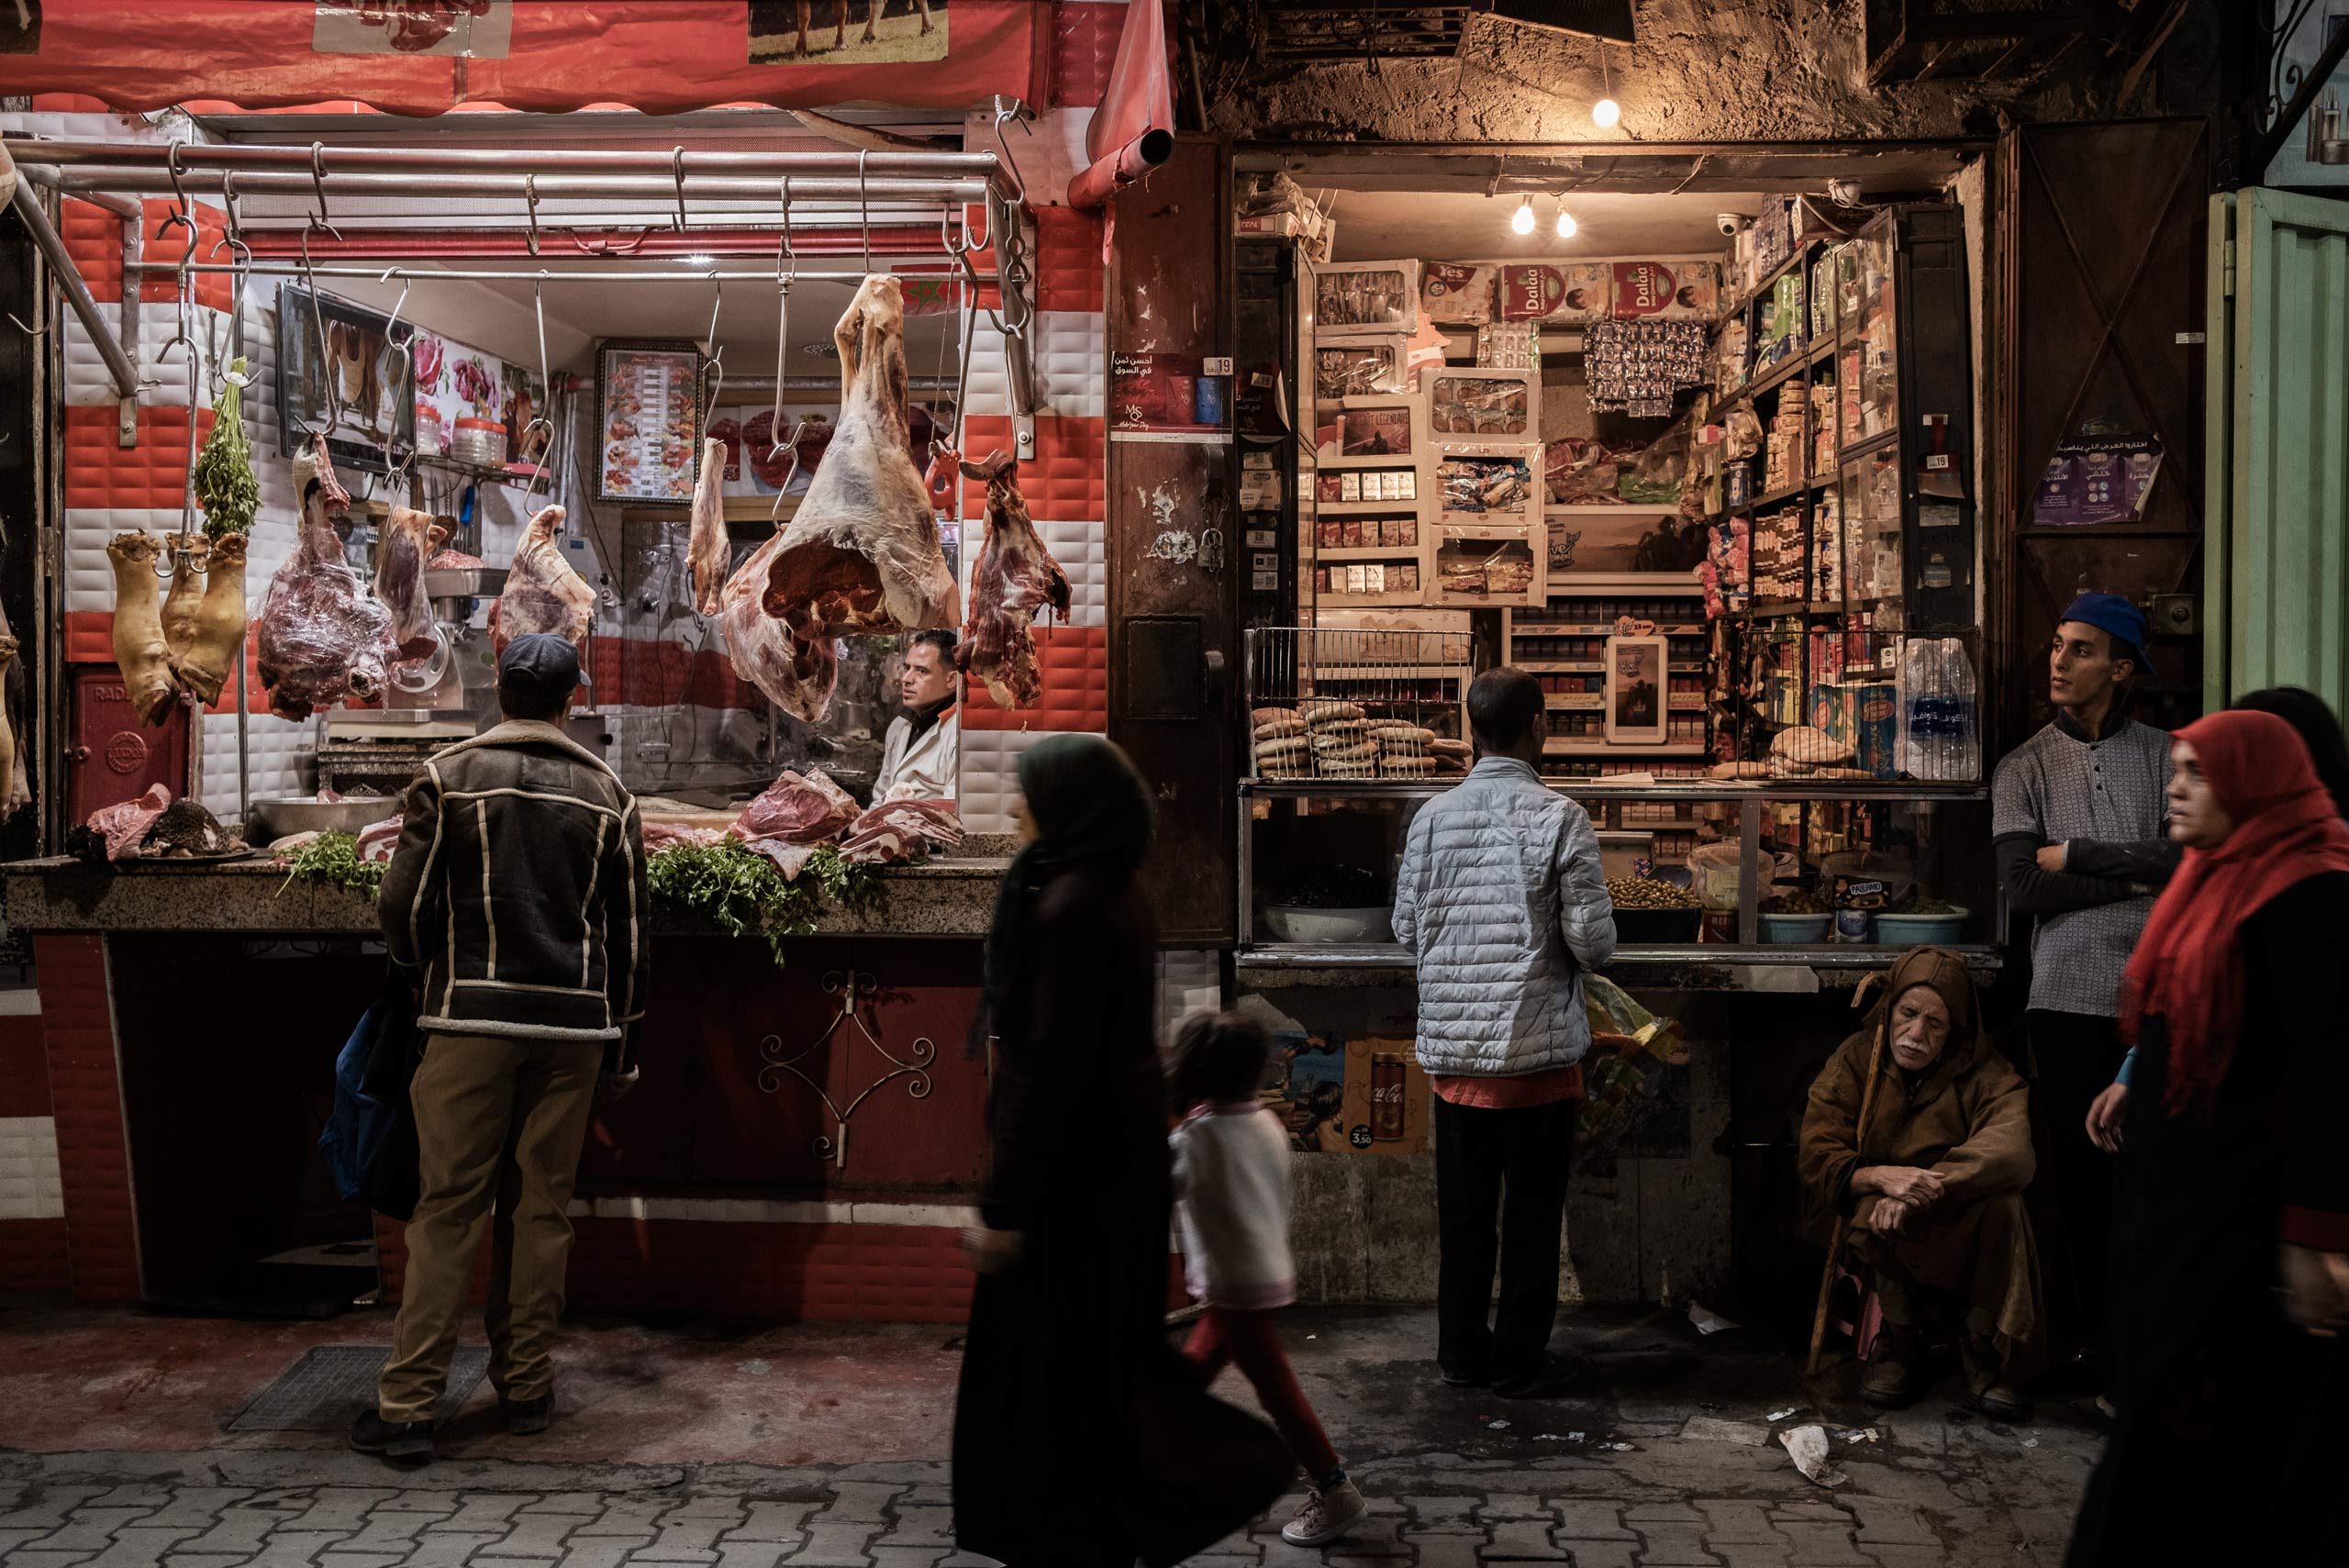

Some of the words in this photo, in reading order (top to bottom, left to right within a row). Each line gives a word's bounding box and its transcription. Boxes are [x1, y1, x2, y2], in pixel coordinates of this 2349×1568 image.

[1439, 265, 1464, 279] Yes
[1525, 269, 1540, 310] Dalaa
[1635, 267, 1650, 306] Dalaa
[1114, 355, 1130, 365] ثمن
[1130, 355, 1152, 364] أحسن
[1115, 367, 1139, 376] السوق
[1218, 359, 1230, 373] 19
[1140, 367, 1152, 377] في
[1936, 456, 1945, 466] 19
[1851, 883, 1881, 894] PALERMO
[1353, 1132, 1372, 1145] 3,50
